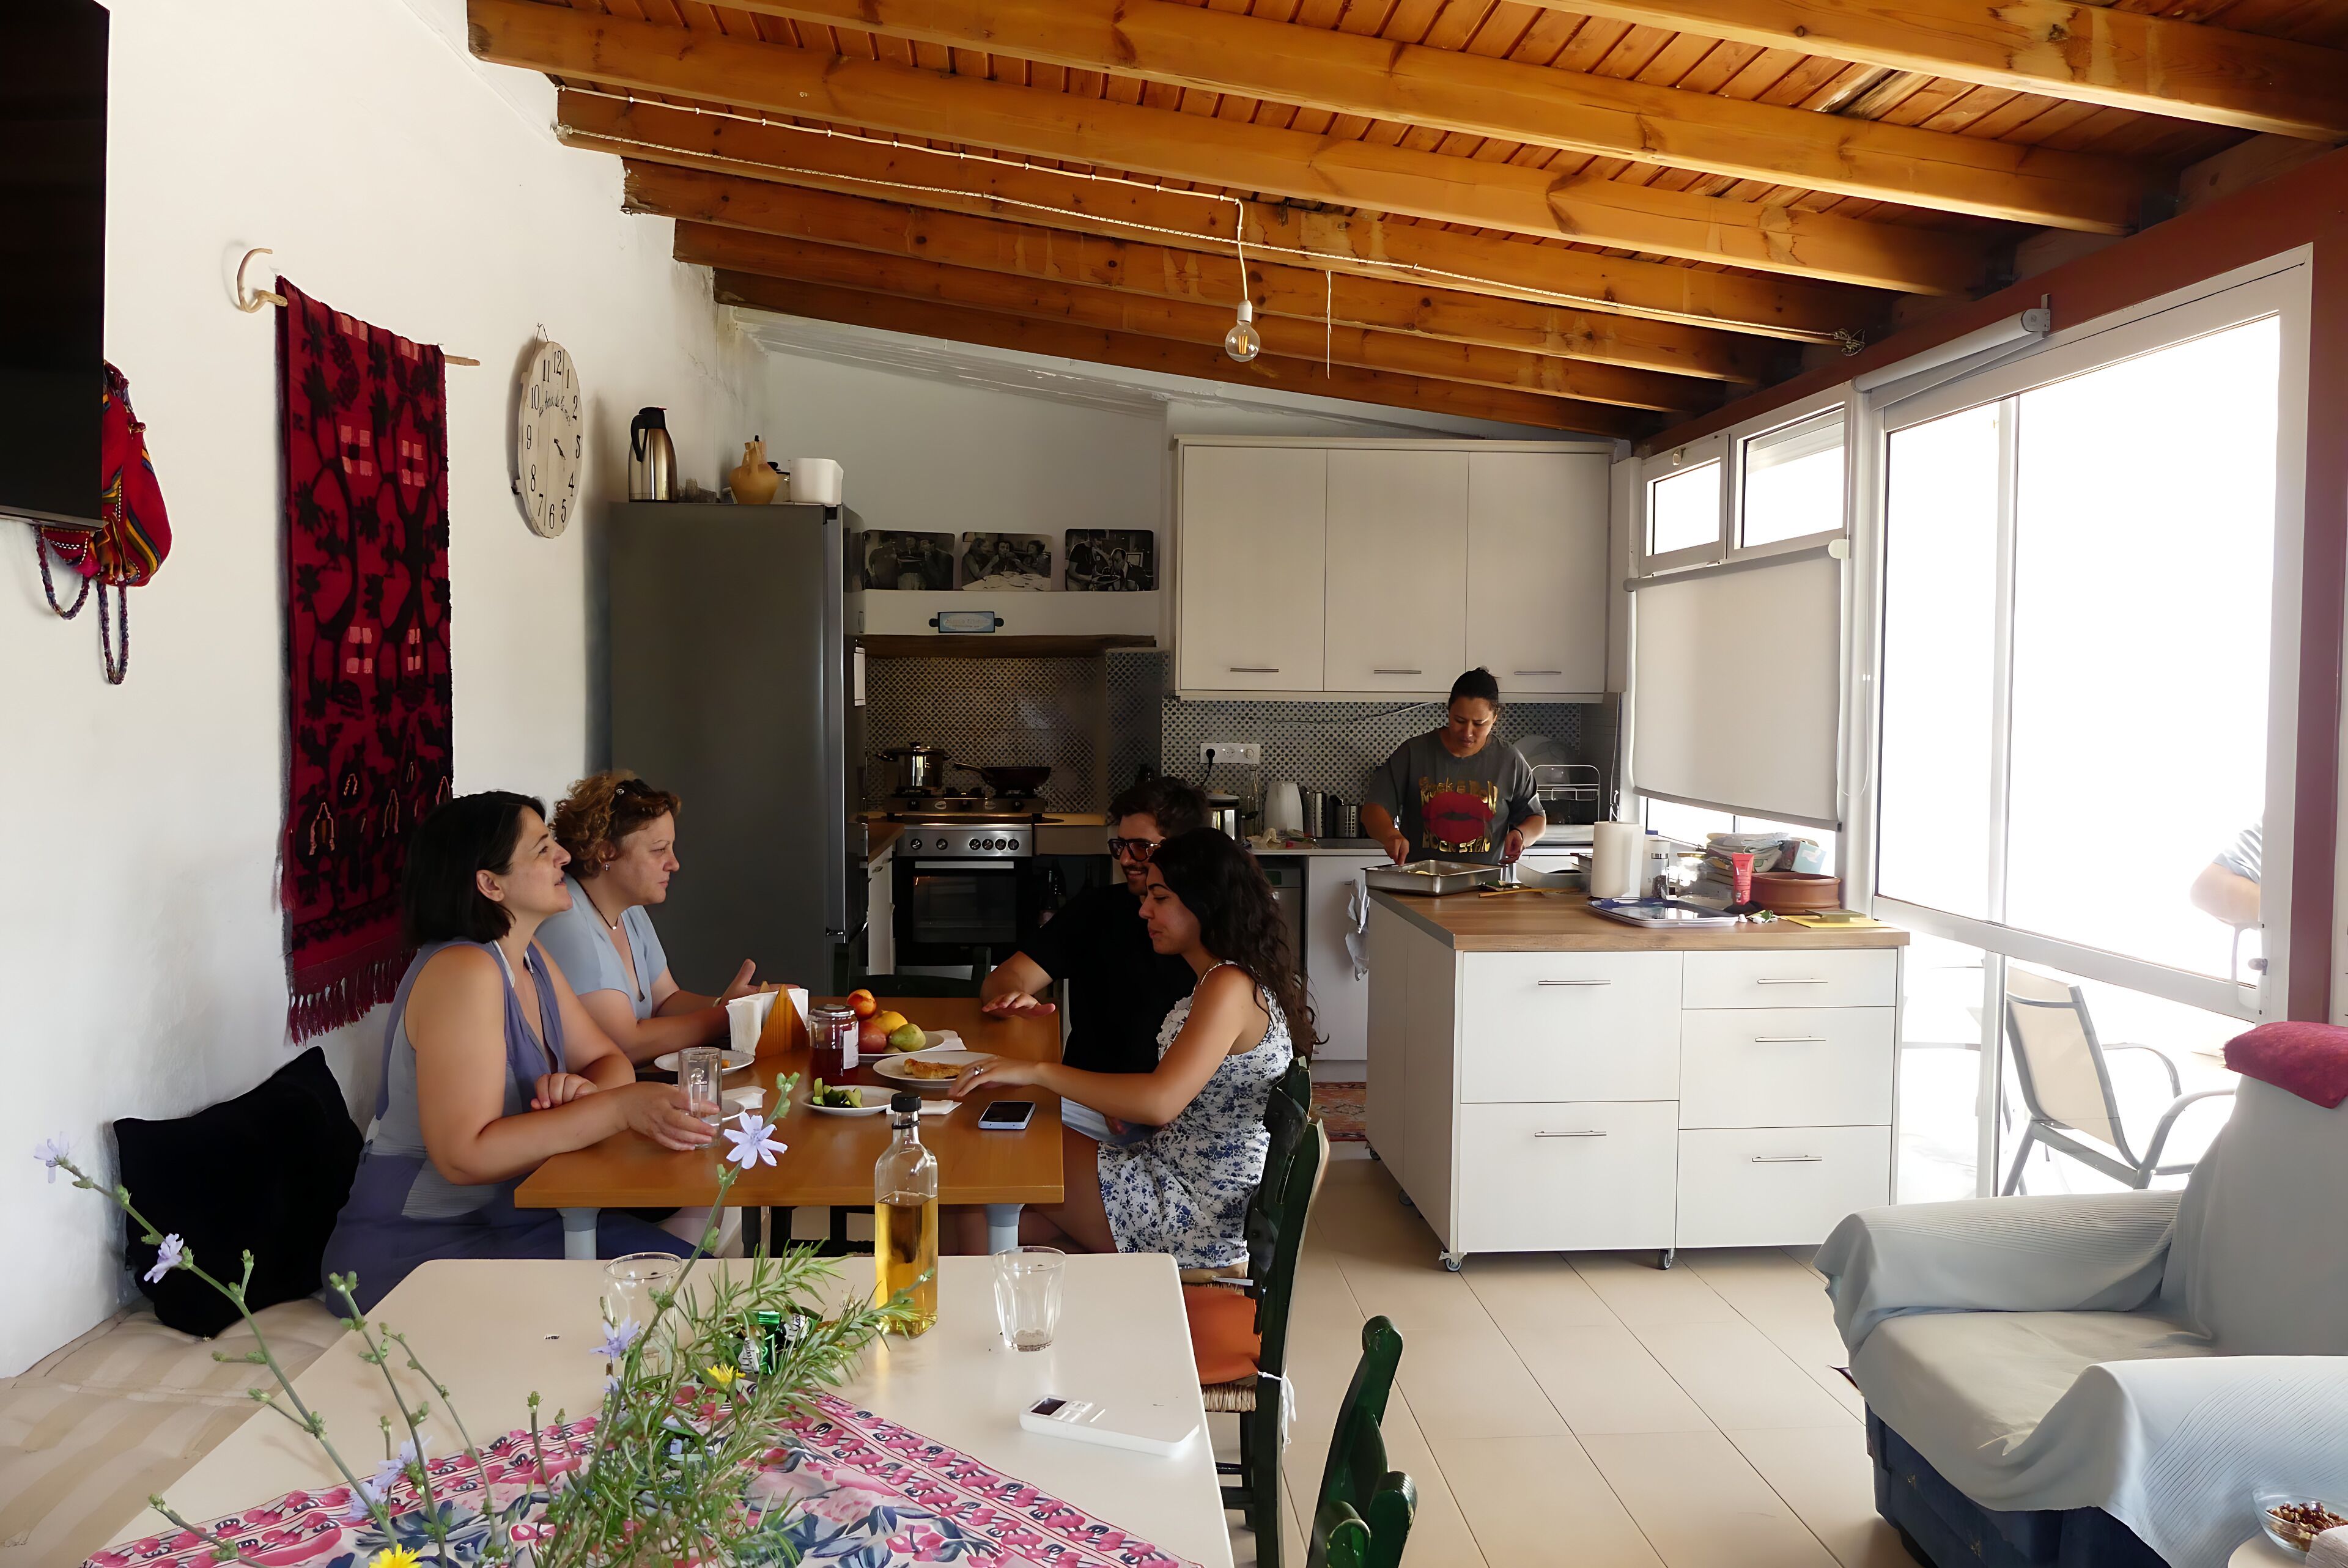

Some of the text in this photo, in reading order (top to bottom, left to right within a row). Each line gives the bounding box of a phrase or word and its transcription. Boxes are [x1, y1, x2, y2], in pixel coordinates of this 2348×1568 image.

[543, 359, 550, 383] 11
[553, 350, 562, 375] 12
[566, 369, 569, 389] 1
[531, 385, 539, 410] 10
[572, 395, 578, 421] 2
[527, 424, 532, 450] 9
[575, 435, 581, 459] 3
[530, 465, 536, 491] 8
[568, 471, 575, 497] 4
[538, 493, 544, 517] 7
[549, 504, 555, 529] 6
[561, 498, 566, 523] 5
